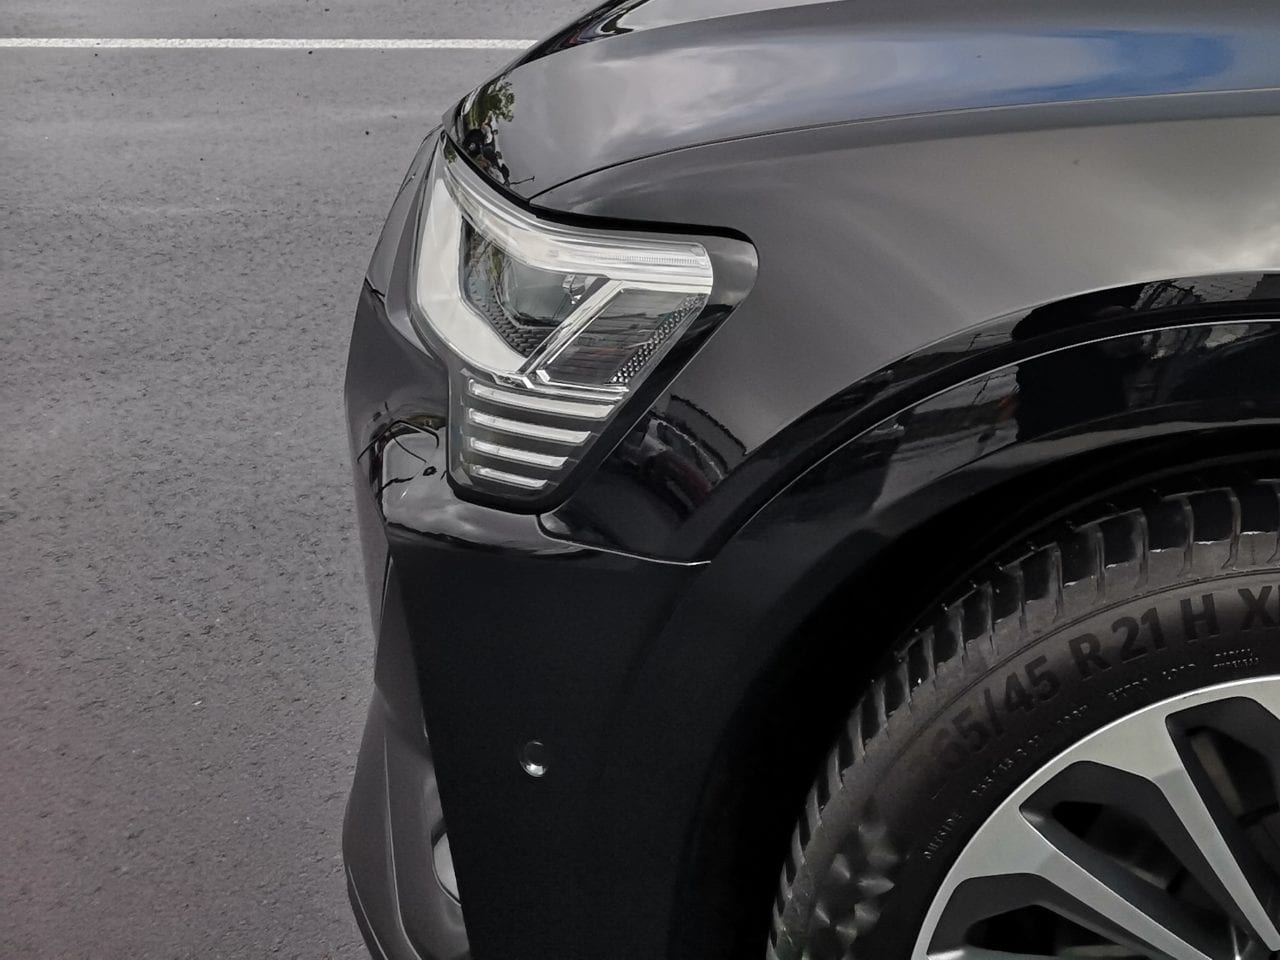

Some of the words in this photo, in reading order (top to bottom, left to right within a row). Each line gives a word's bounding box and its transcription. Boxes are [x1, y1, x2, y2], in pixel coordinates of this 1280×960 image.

[1068, 633, 1112, 682] R
[1110, 607, 1168, 665] 21
[1179, 593, 1222, 643] H
